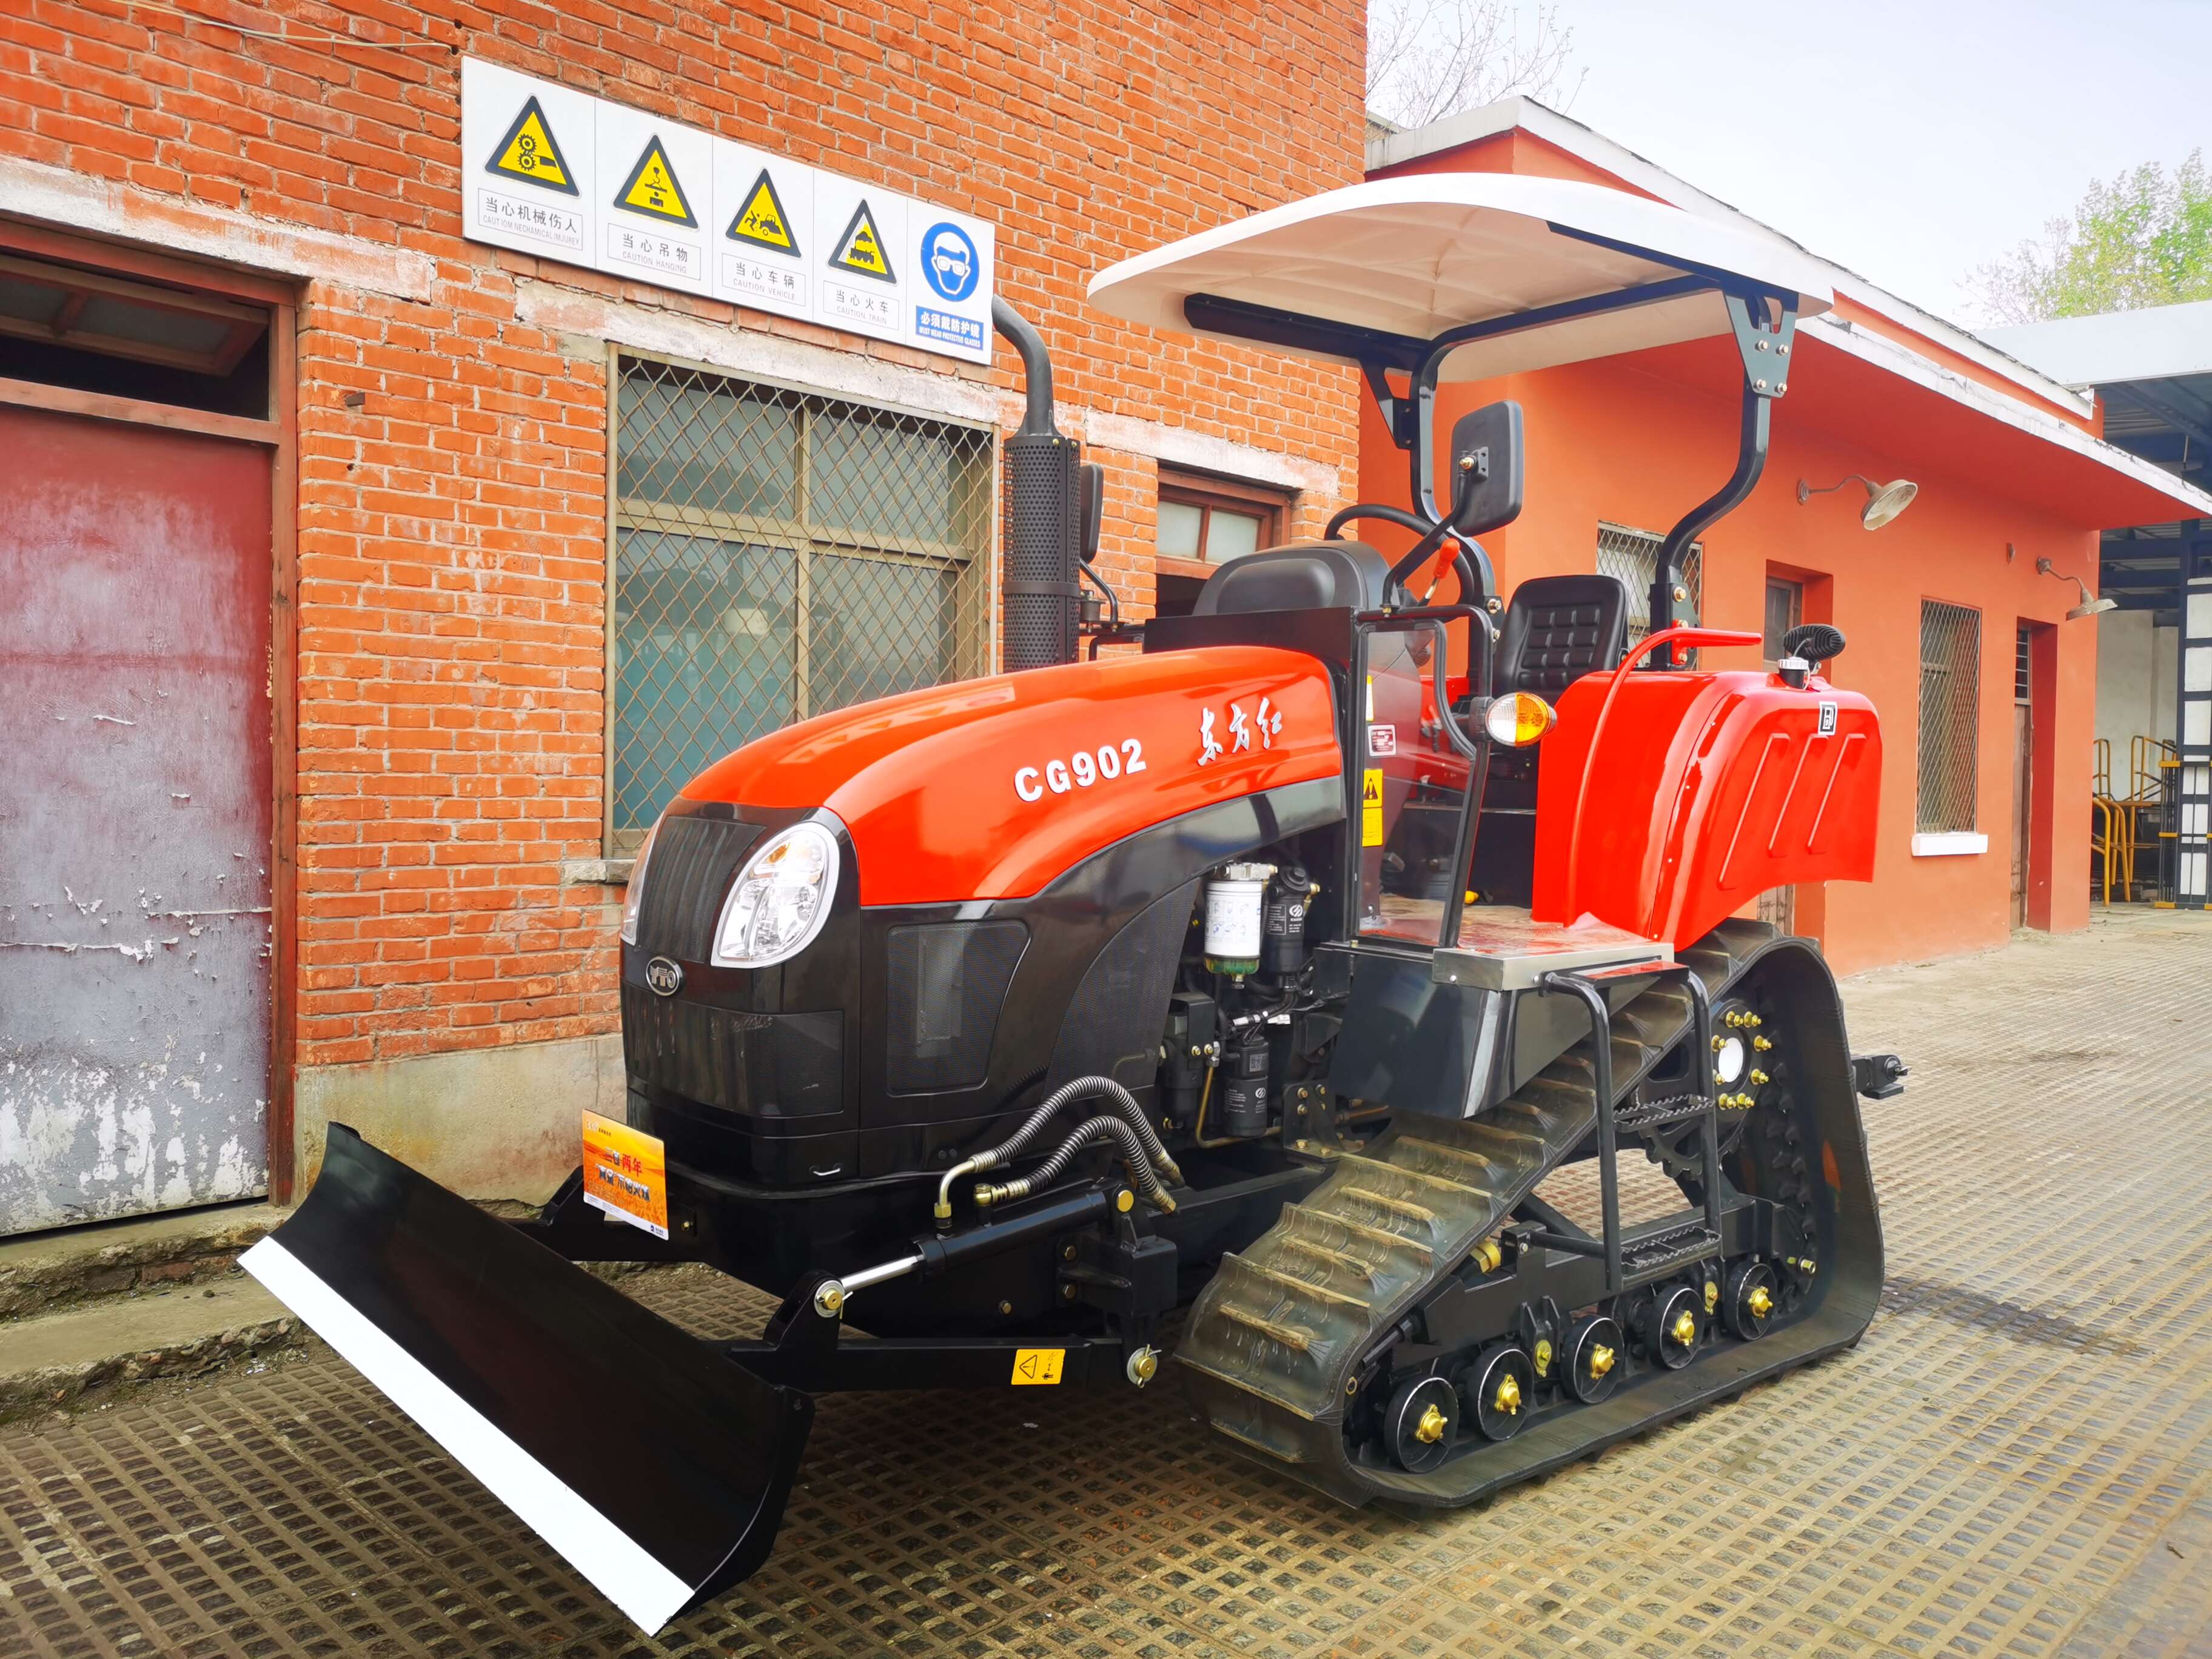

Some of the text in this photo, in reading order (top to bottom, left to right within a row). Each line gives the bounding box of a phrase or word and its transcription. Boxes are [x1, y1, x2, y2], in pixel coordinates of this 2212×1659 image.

[486, 197, 577, 233] 当心机械伤人
[623, 233, 688, 263] 当心吊物
[623, 251, 686, 273] CAUTION HANGING
[736, 261, 794, 289] 当心车辆
[733, 278, 796, 301] CAUTION VEHICLE
[836, 289, 888, 313] 当心火车
[837, 306, 887, 324] CAUTION TRAIN
[920, 310, 980, 338] 必须戴防护镜
[919, 326, 980, 348] MUST WEAR PROTECTIVE GLASSES
[1197, 697, 1283, 766] 东方红
[1014, 738, 1147, 802] CG902
[649, 965, 676, 989] YTO
